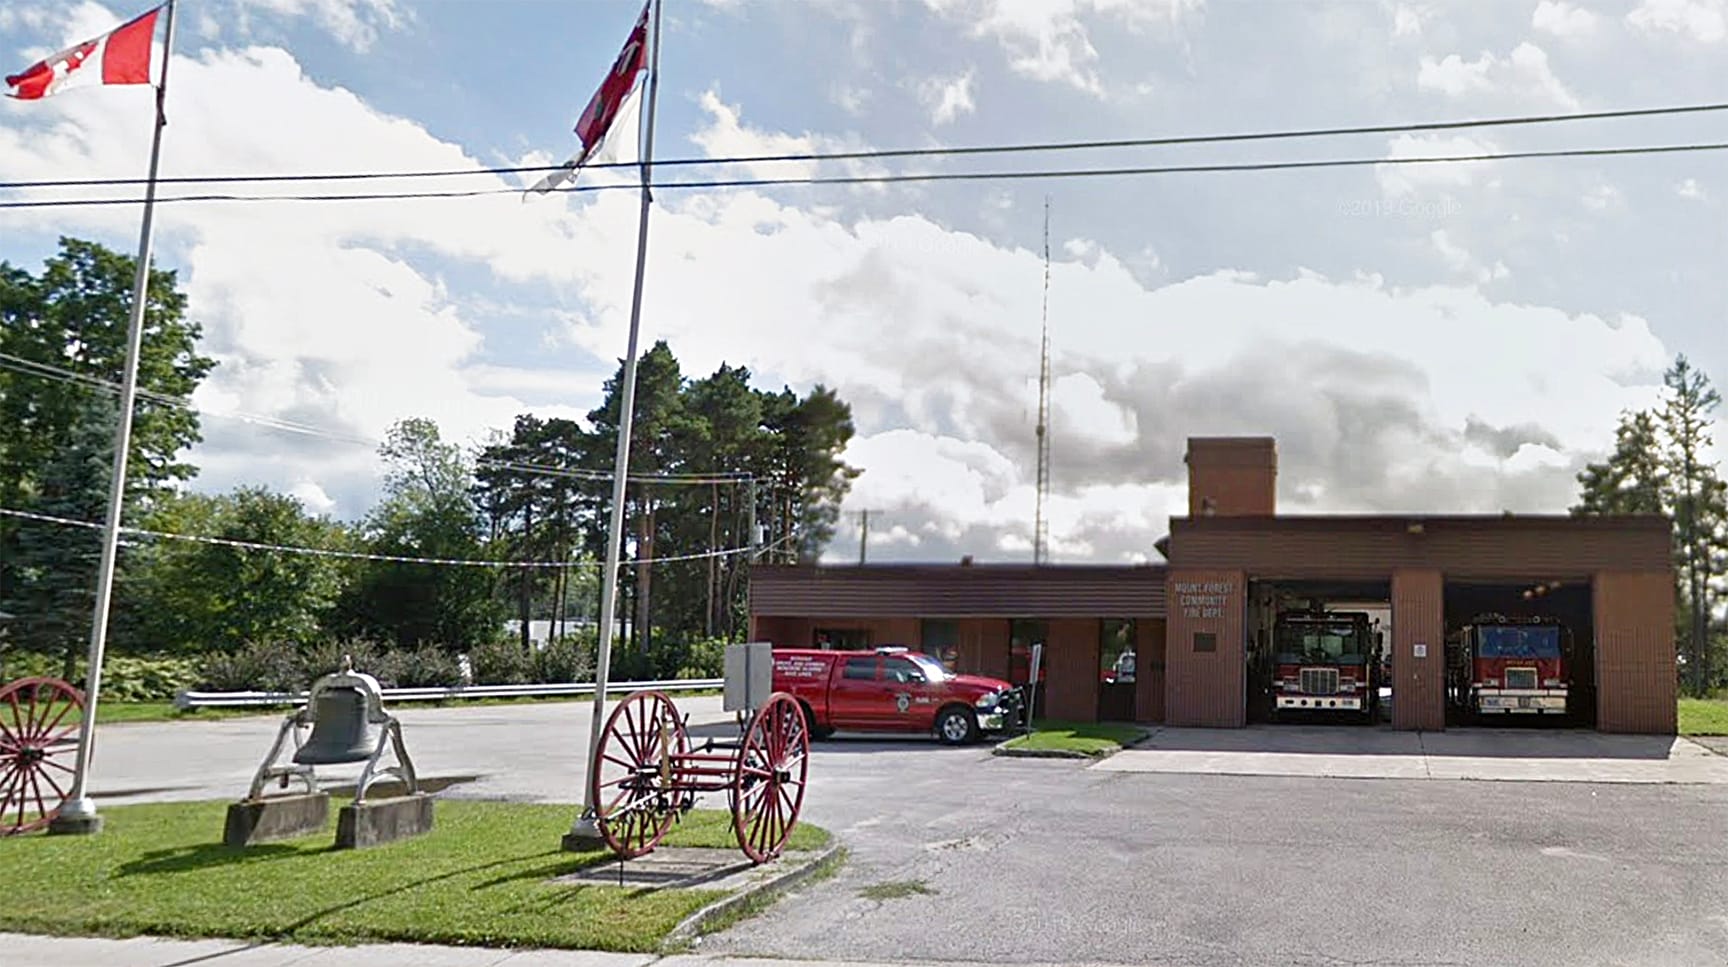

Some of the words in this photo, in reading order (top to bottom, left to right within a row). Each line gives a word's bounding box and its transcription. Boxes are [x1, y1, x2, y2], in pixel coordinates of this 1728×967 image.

[1175, 583, 1202, 593] MOUNT
[1203, 583, 1233, 593] FOREST
[1180, 595, 1228, 606] COMMUNITY
[1184, 607, 1201, 618] FIRE
